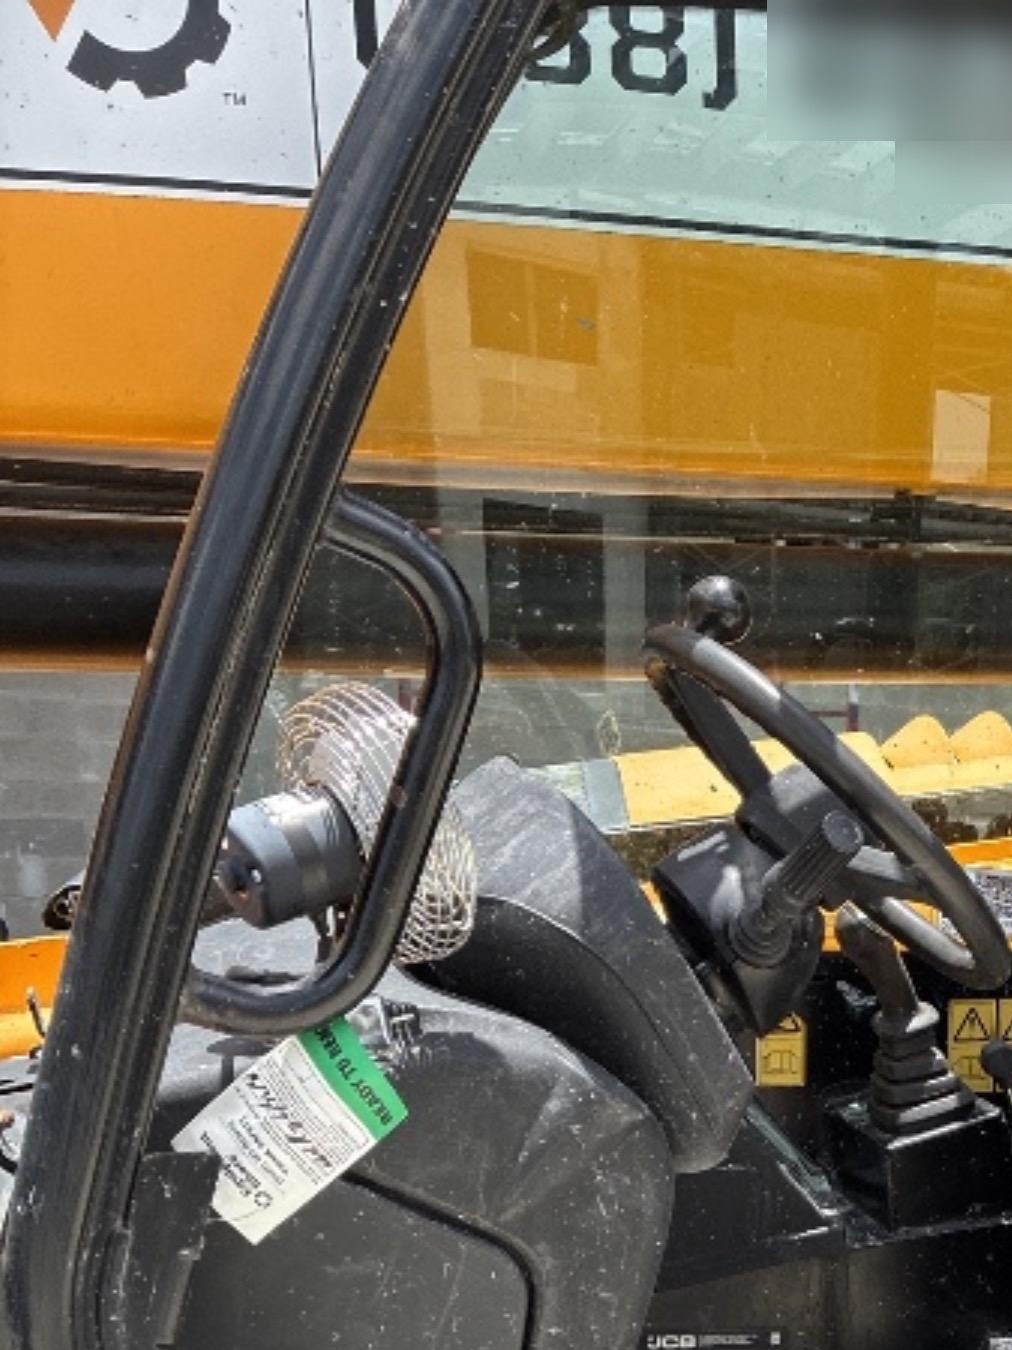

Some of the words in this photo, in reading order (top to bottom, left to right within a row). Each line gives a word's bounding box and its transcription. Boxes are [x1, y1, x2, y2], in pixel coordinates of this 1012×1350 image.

[335, 1056, 358, 1081] TO
[349, 1077, 394, 1126] READY
[646, 1333, 698, 1350] JCB
